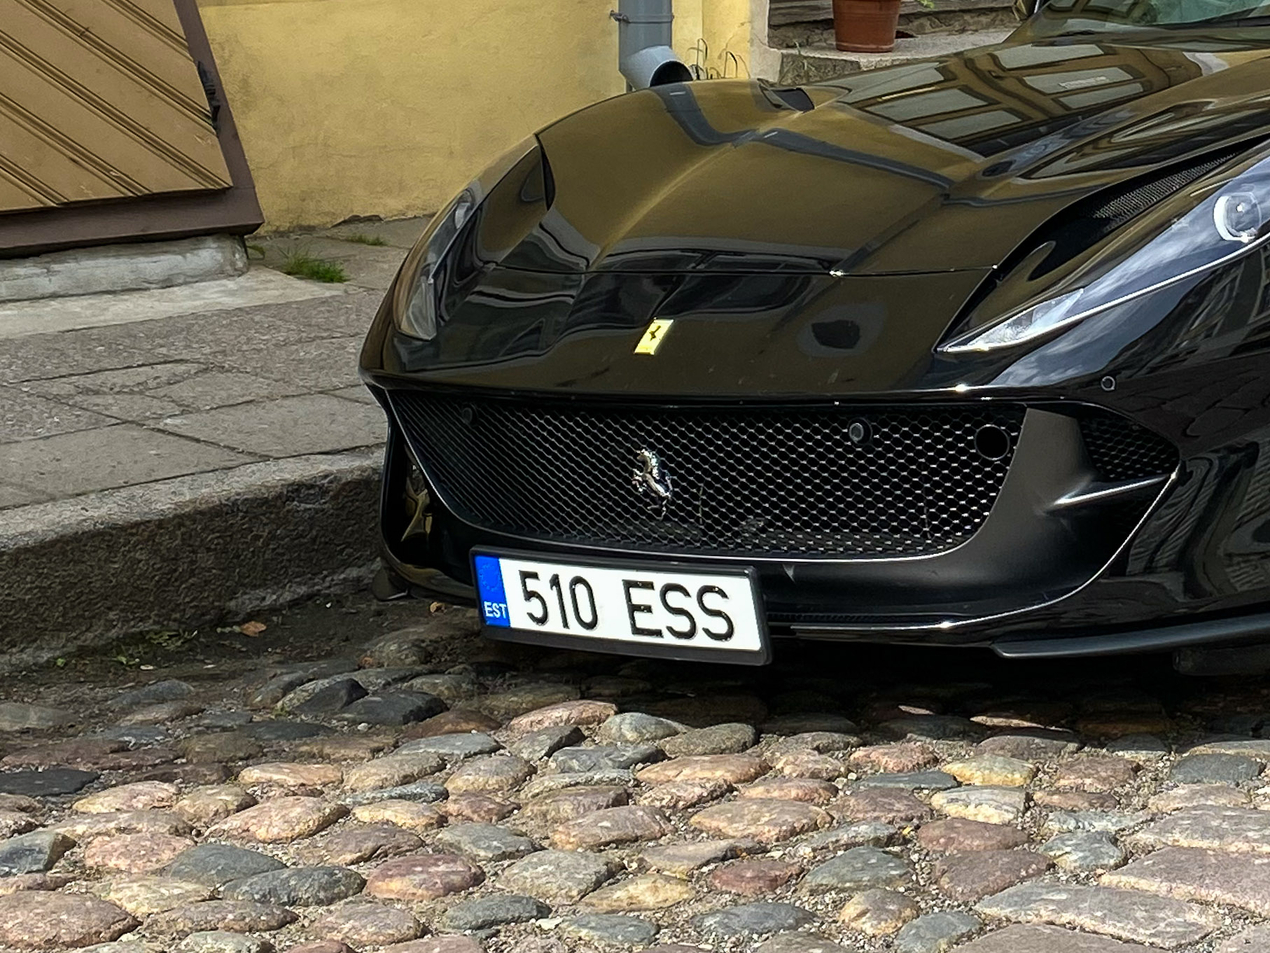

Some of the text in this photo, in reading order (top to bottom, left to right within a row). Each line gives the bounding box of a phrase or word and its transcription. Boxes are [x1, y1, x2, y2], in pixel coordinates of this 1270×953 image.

[483, 569, 735, 641] EST 510 ESS
